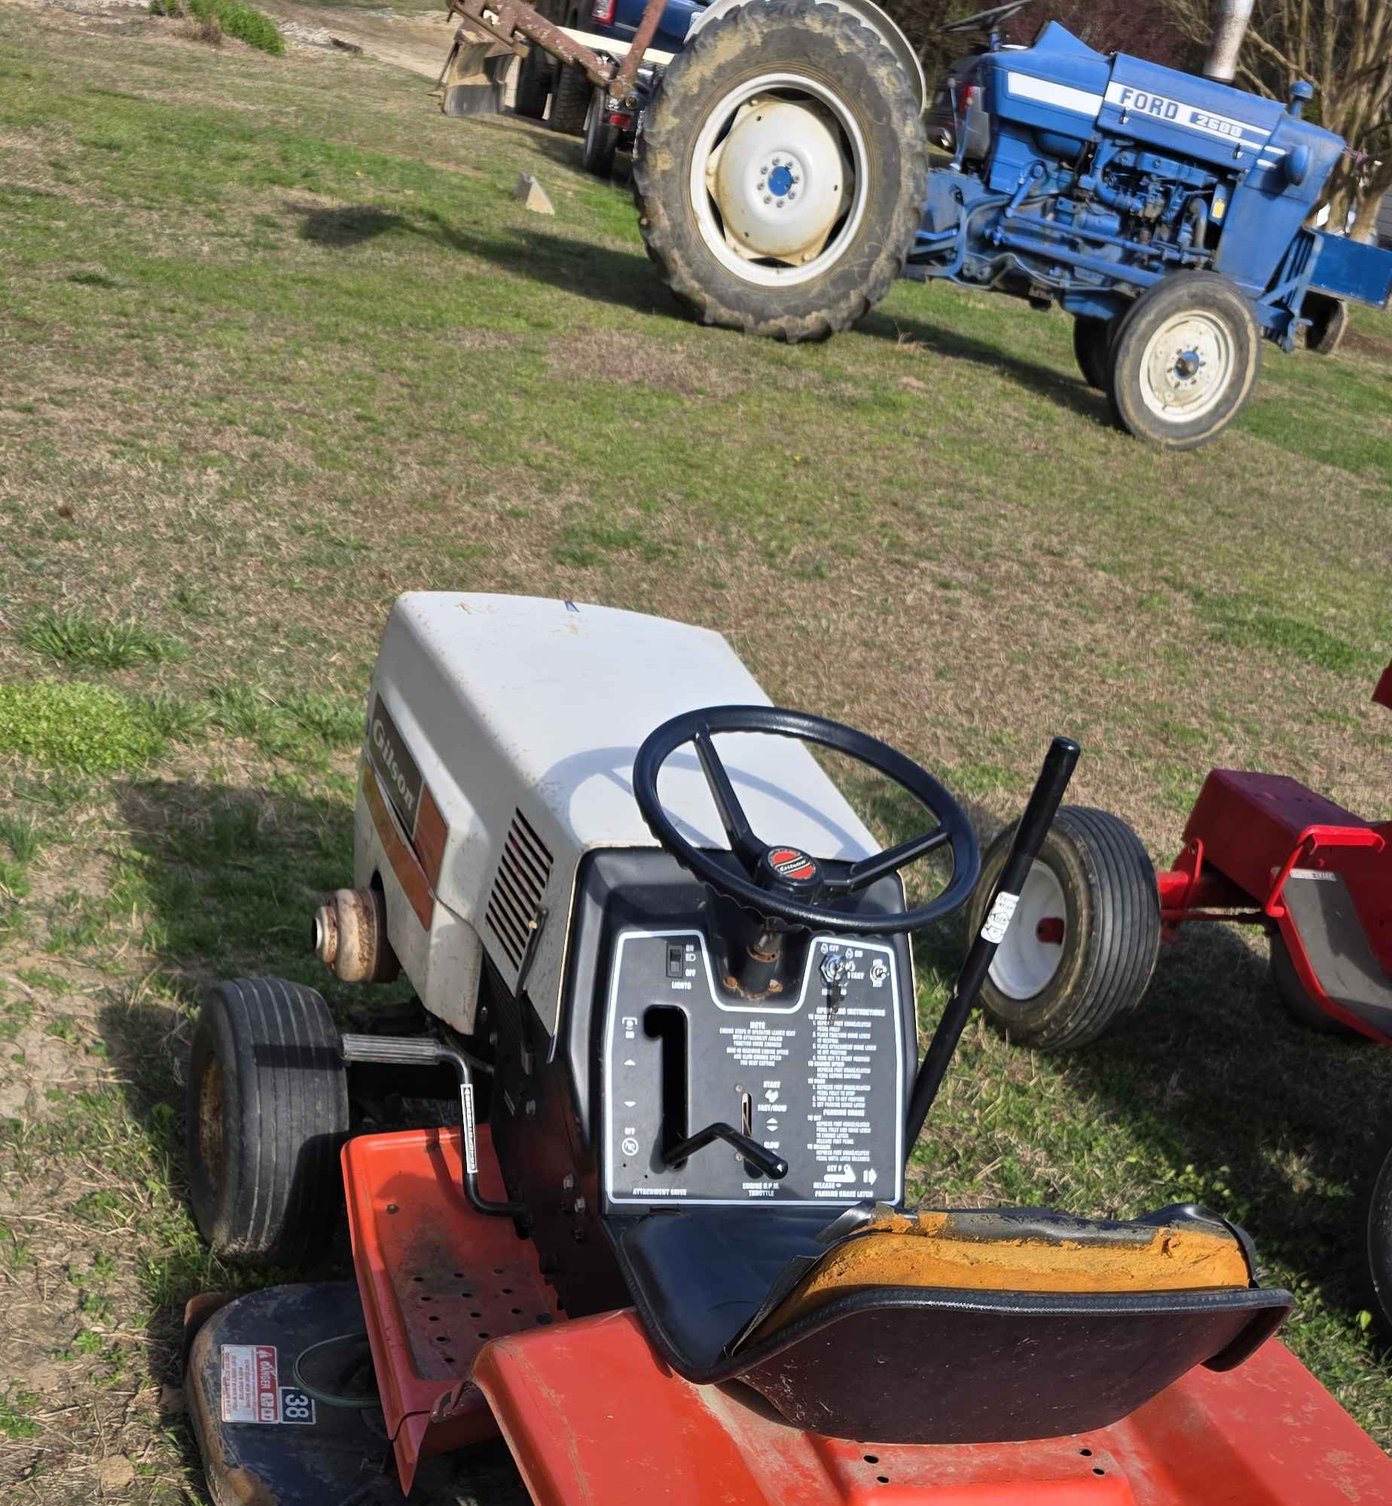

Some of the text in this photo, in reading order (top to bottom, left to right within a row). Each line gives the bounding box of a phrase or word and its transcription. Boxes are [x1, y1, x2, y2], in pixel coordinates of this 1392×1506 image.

[1120, 87, 1179, 120] FORD
[373, 719, 415, 811] Gilson
[671, 981, 692, 990] LIGHTS
[763, 1080, 780, 1088] START
[632, 1188, 669, 1196] ATTACHMENT
[285, 1393, 310, 1418] 38
